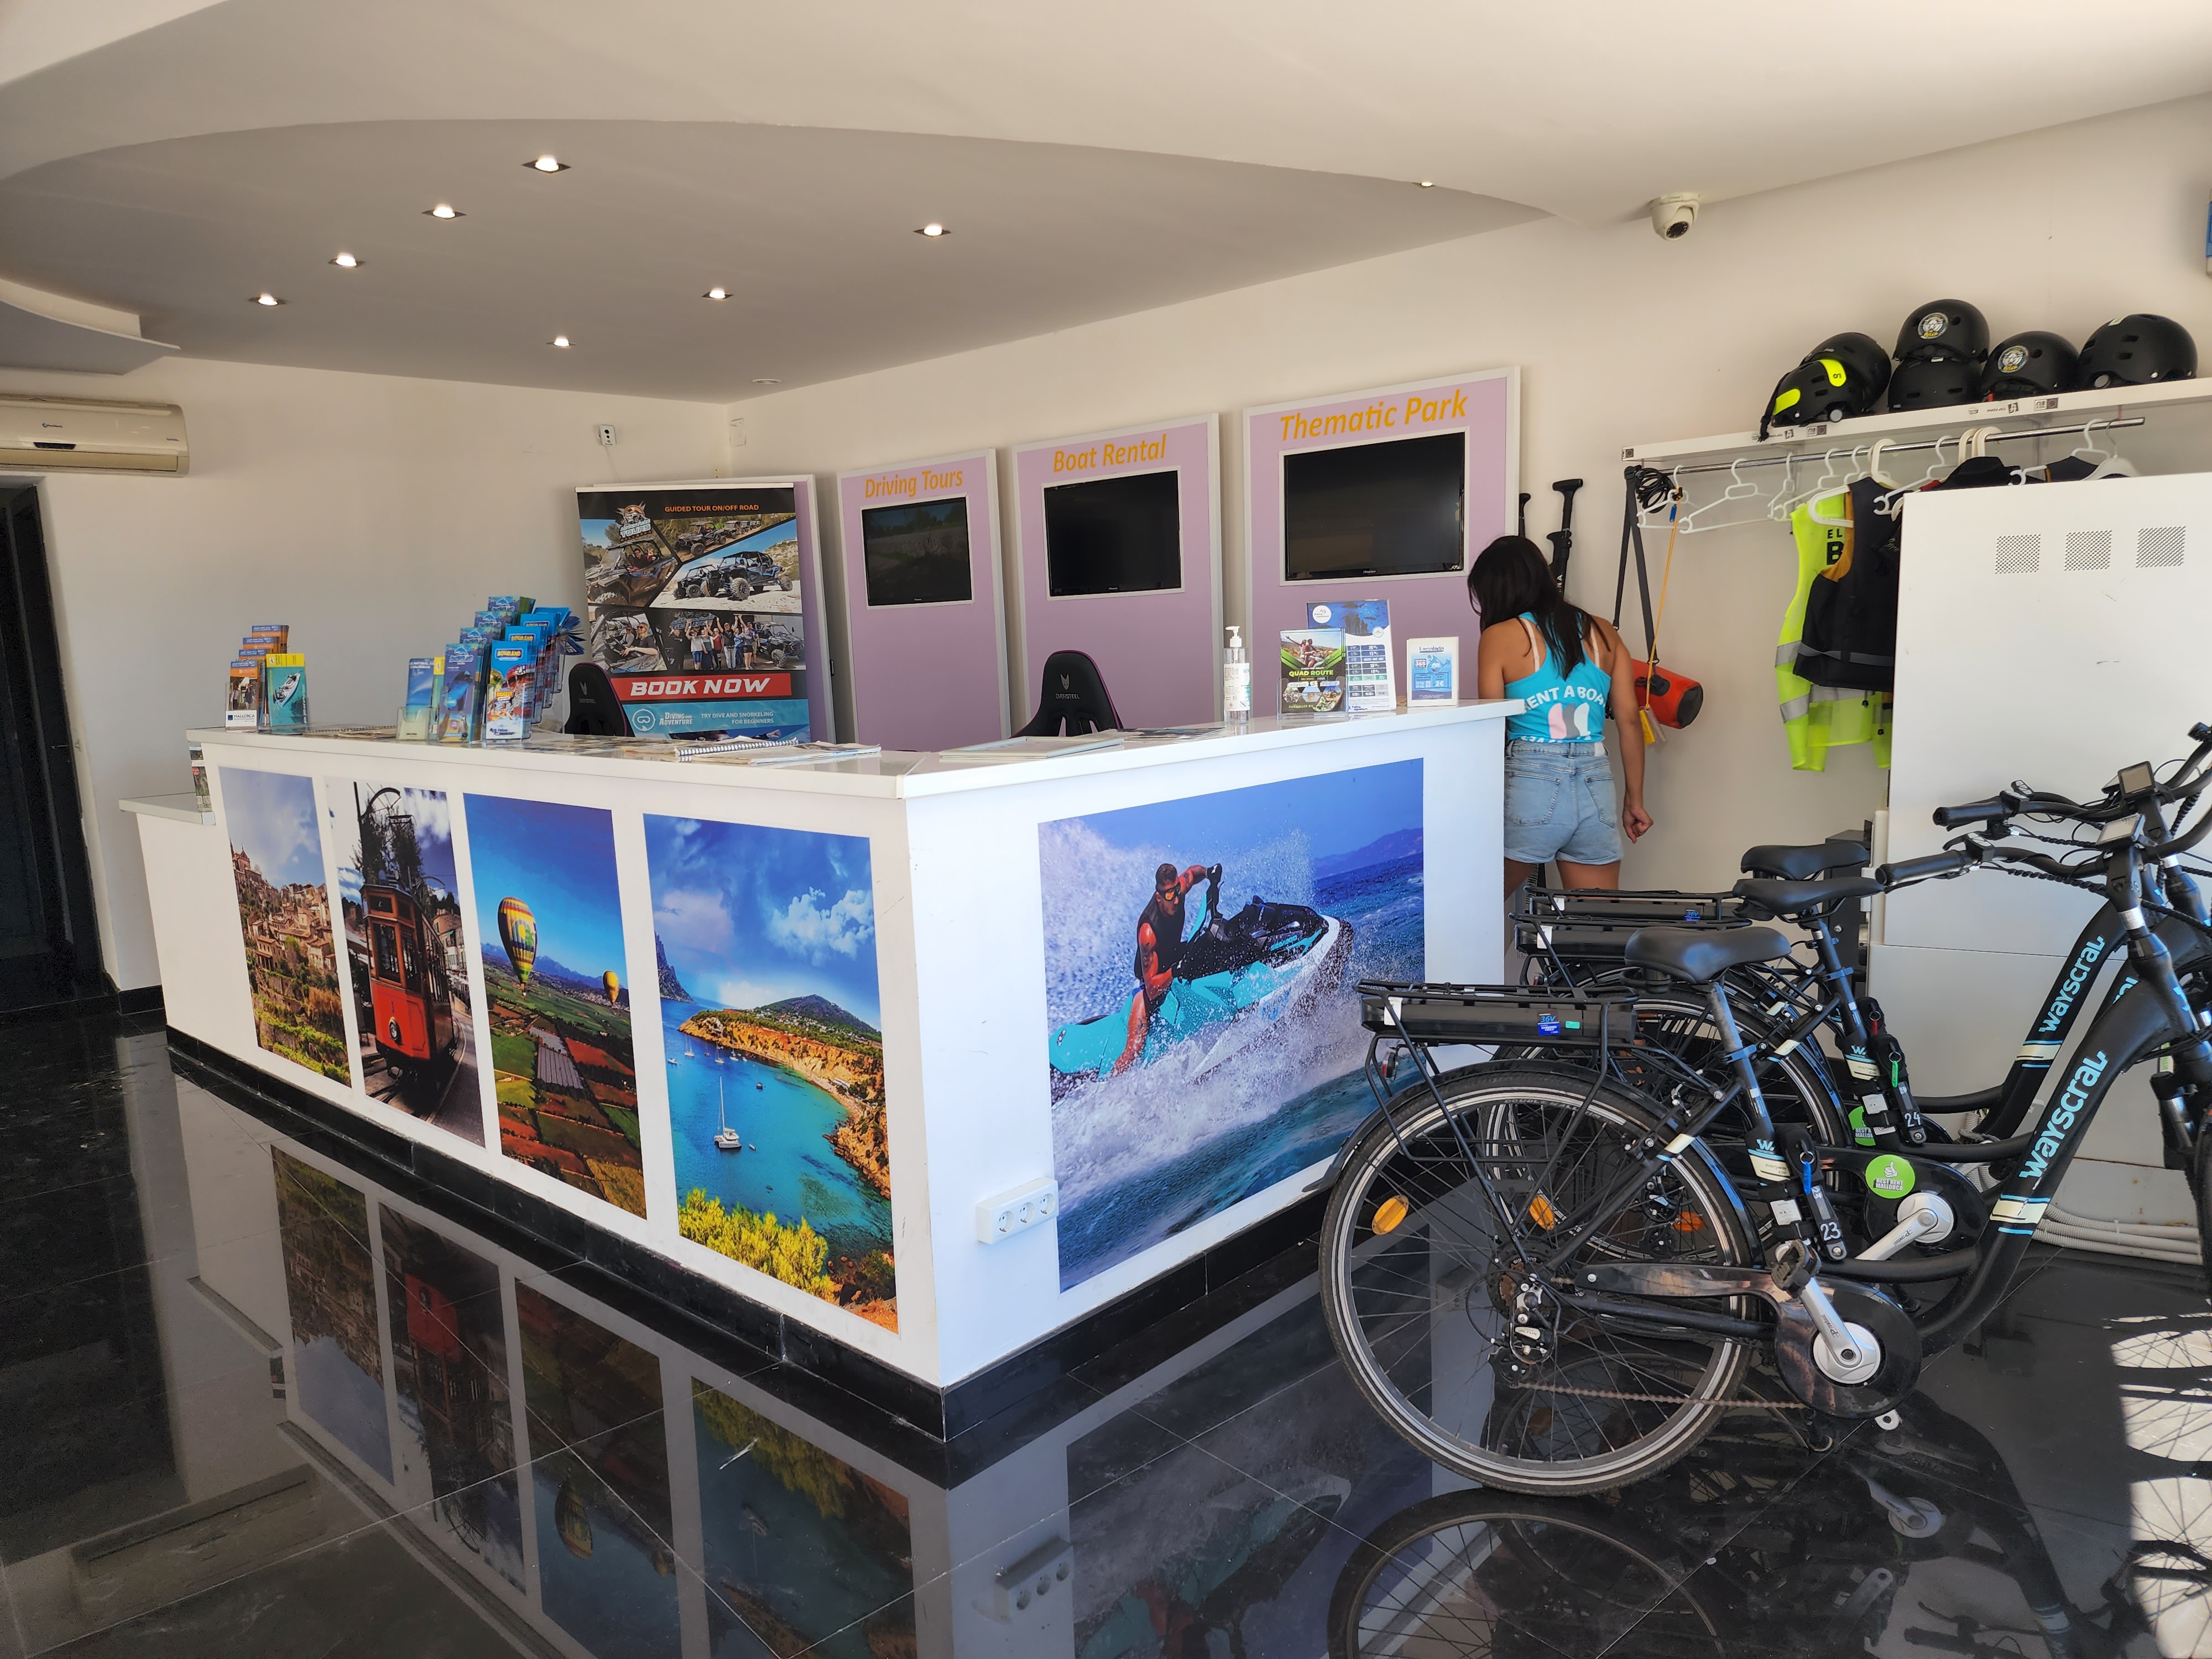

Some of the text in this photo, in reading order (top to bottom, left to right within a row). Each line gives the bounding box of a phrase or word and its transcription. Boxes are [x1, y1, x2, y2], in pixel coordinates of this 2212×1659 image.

[1280, 389, 1468, 441] Thematic Park
[1053, 434, 1167, 473] Boat Rental
[865, 468, 963, 499] Driving Tours
[620, 524, 651, 538] TOURS
[630, 678, 771, 696] BOOK NOW
[1563, 685, 1575, 698] A
[1577, 686, 1605, 707] BOA
[2039, 935, 2105, 1032] wayscral
[1905, 1112, 1921, 1128] 24
[2018, 1050, 2109, 1178] wayscral
[1820, 1222, 1841, 1241] 23
